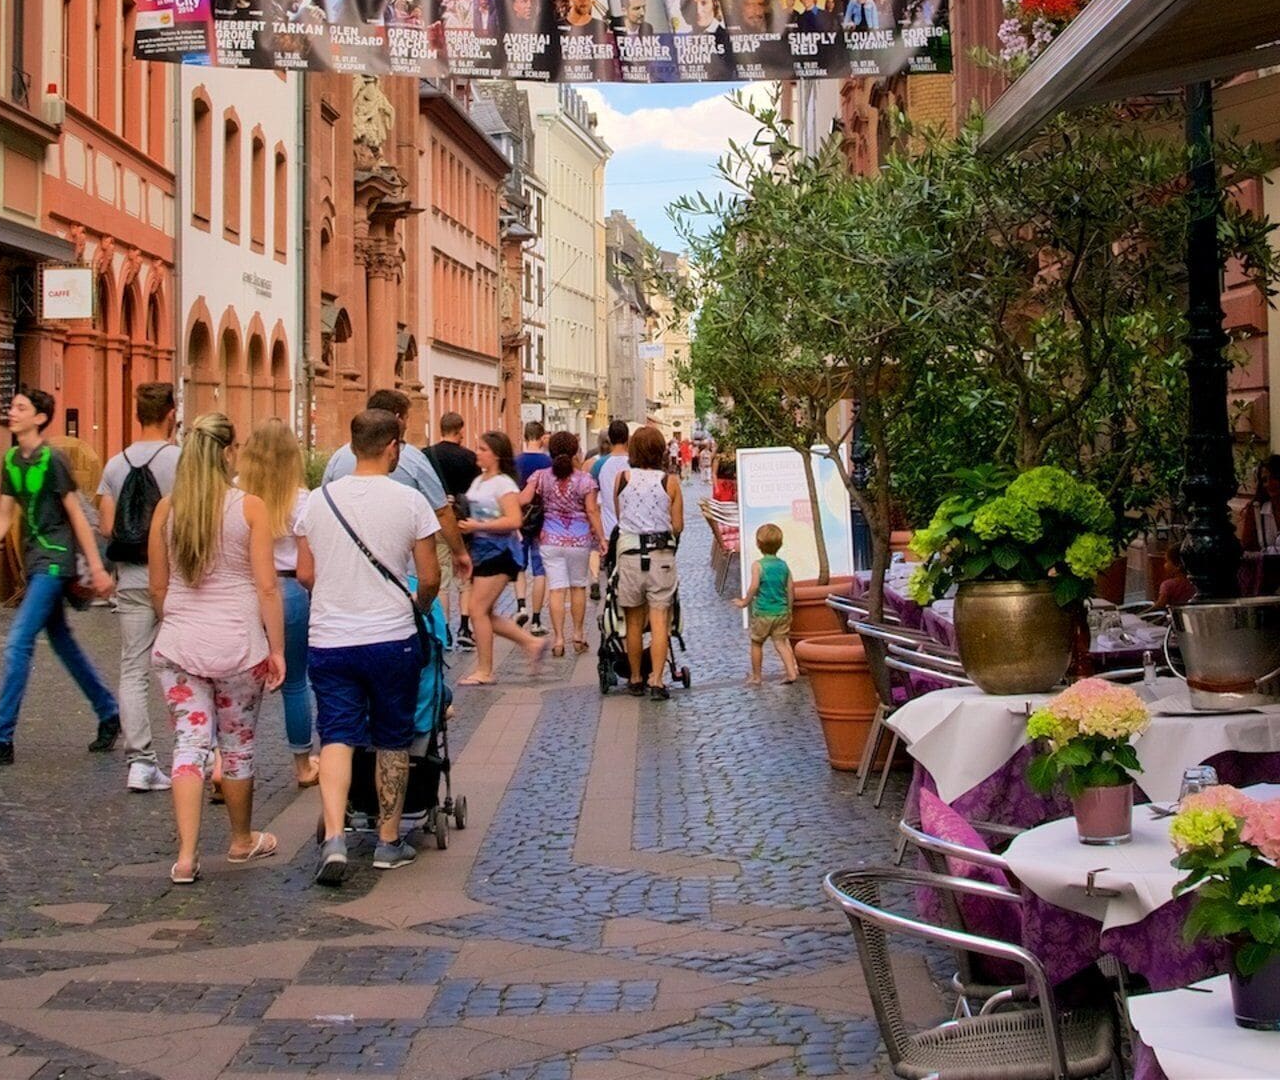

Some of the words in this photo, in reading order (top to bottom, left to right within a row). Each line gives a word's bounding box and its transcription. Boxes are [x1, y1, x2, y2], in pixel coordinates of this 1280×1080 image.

[214, 19, 267, 32] HERBERT
[271, 22, 324, 36] TARKAN
[329, 25, 359, 37] GLEN
[387, 28, 428, 42] OPERN
[503, 32, 551, 46] AVISHAI
[787, 31, 837, 45] SIMPLY
[843, 29, 894, 43] LOUANE
[900, 26, 949, 39] FOREIG-
[216, 39, 256, 50] MEYER
[330, 34, 384, 46] HANSARD
[389, 38, 430, 50] NACHT
[560, 35, 595, 47] MARK
[617, 35, 662, 47] FRANK
[673, 35, 717, 47] DIETER
[904, 37, 928, 48] NER
[390, 46, 409, 58] AM
[411, 48, 438, 60] DOM
[504, 41, 546, 54] COHEN
[562, 43, 614, 56] FORSTER
[618, 45, 671, 58] TURNER
[675, 43, 726, 55] THOMAS
[732, 41, 761, 53] BAP
[790, 43, 819, 56] RED
[506, 52, 534, 63] TRIO
